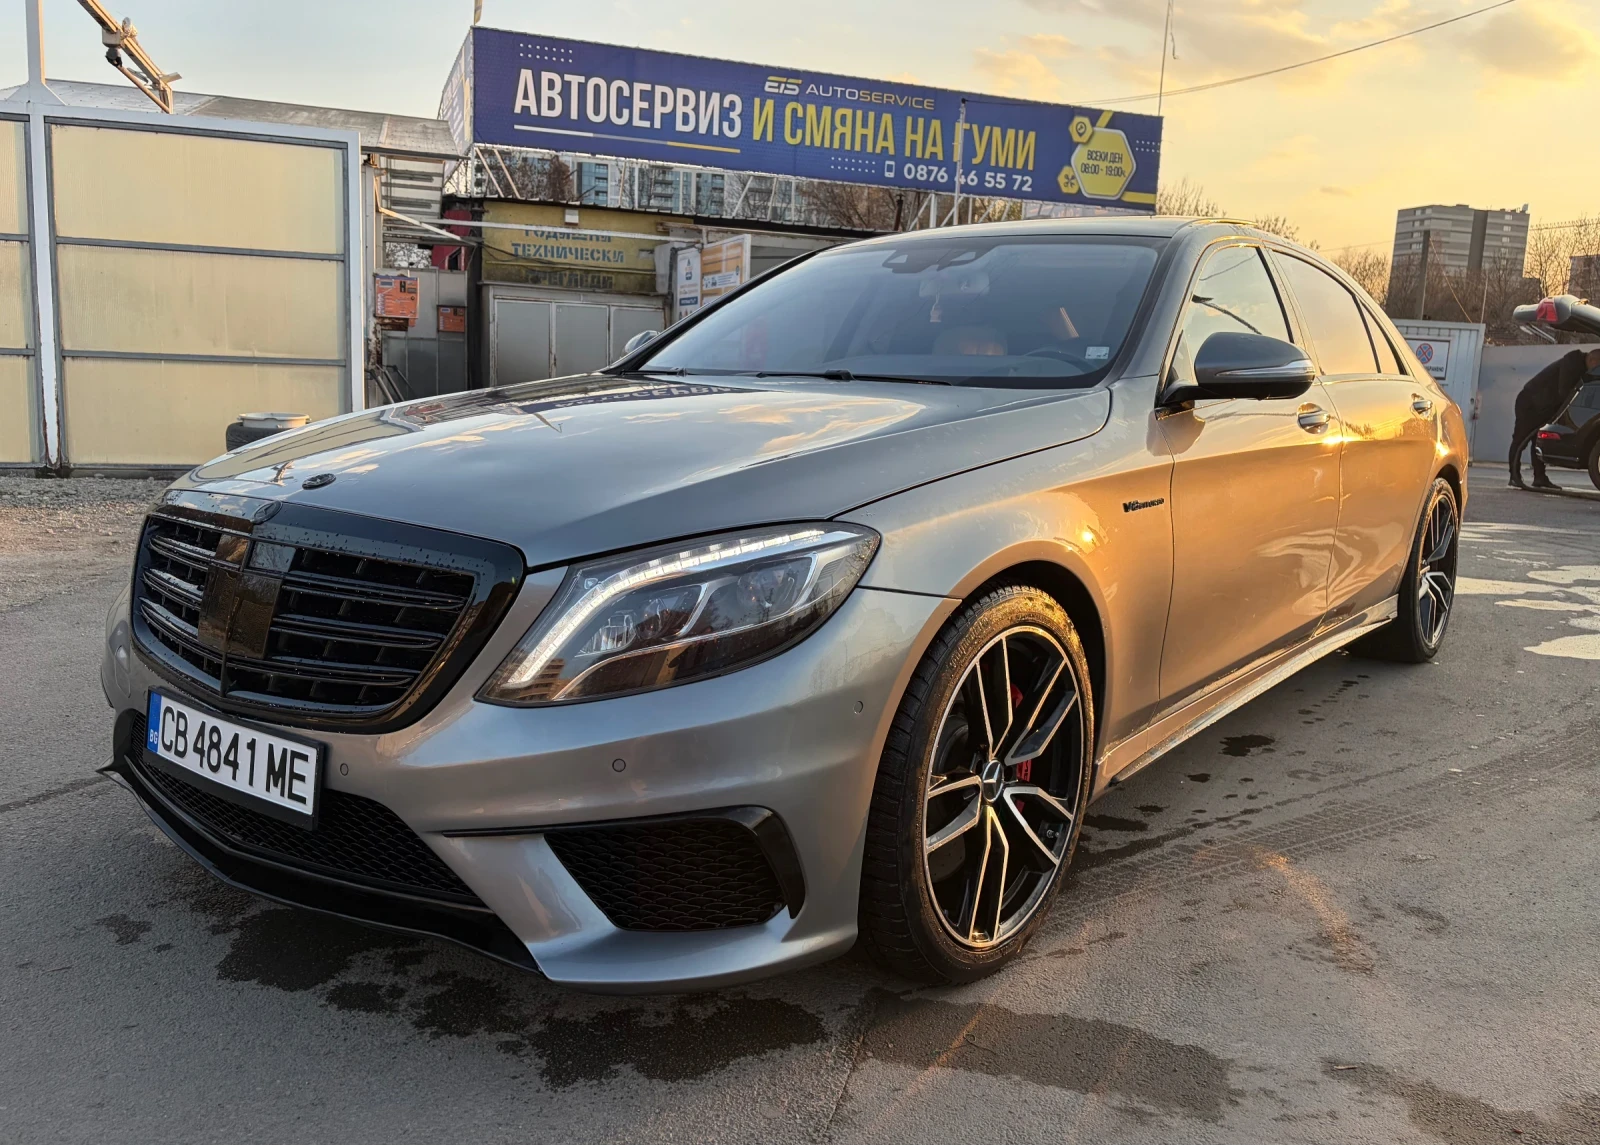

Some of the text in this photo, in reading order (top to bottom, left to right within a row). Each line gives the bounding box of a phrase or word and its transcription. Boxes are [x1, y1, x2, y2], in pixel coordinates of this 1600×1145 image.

[806, 84, 935, 110] AUTOSERVICE
[514, 68, 743, 138] АВТОСЕРВИЗ
[753, 97, 775, 142] И
[784, 101, 896, 155] СМЯНА
[904, 115, 944, 161] НА
[953, 121, 1036, 171] ГУМИ
[1087, 150, 1123, 164] ВСЕКИ ДЕН
[903, 163, 949, 183] 0876
[984, 171, 1006, 189] 55
[1012, 174, 1033, 192] 72
[1080, 163, 1100, 175] 08:00
[511, 243, 625, 263] ТЕХНИЧЕСКИ
[149, 728, 158, 745] BG
[161, 706, 309, 804] CB 4841 ME
